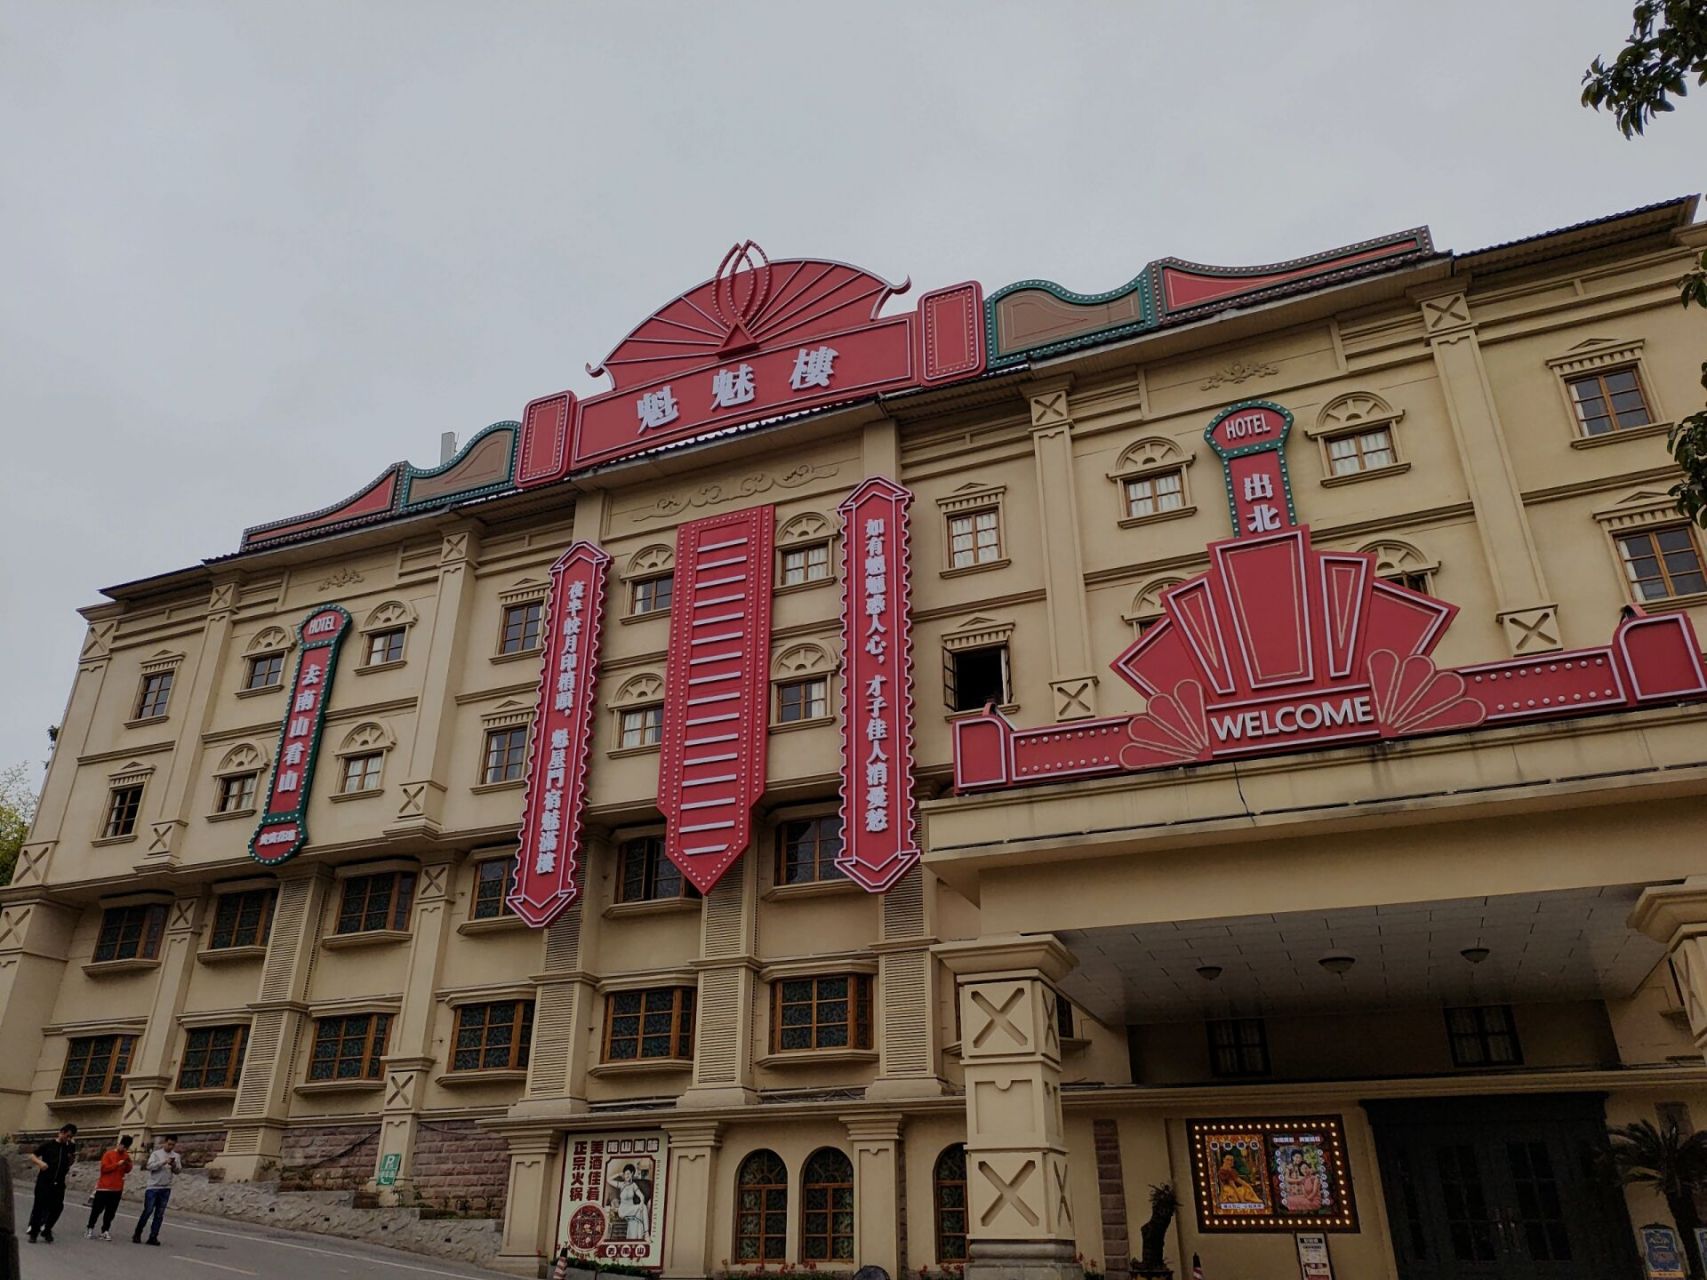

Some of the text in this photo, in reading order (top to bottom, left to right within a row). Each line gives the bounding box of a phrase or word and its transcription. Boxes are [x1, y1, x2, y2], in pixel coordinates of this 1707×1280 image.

[637, 346, 839, 434] 魁魅樓
[1225, 413, 1270, 440] HOTEL
[1243, 473, 1281, 533] 出北
[309, 615, 335, 635] HOTEL
[277, 663, 321, 793] 去南山看山
[1210, 695, 1374, 742] WELCOME
